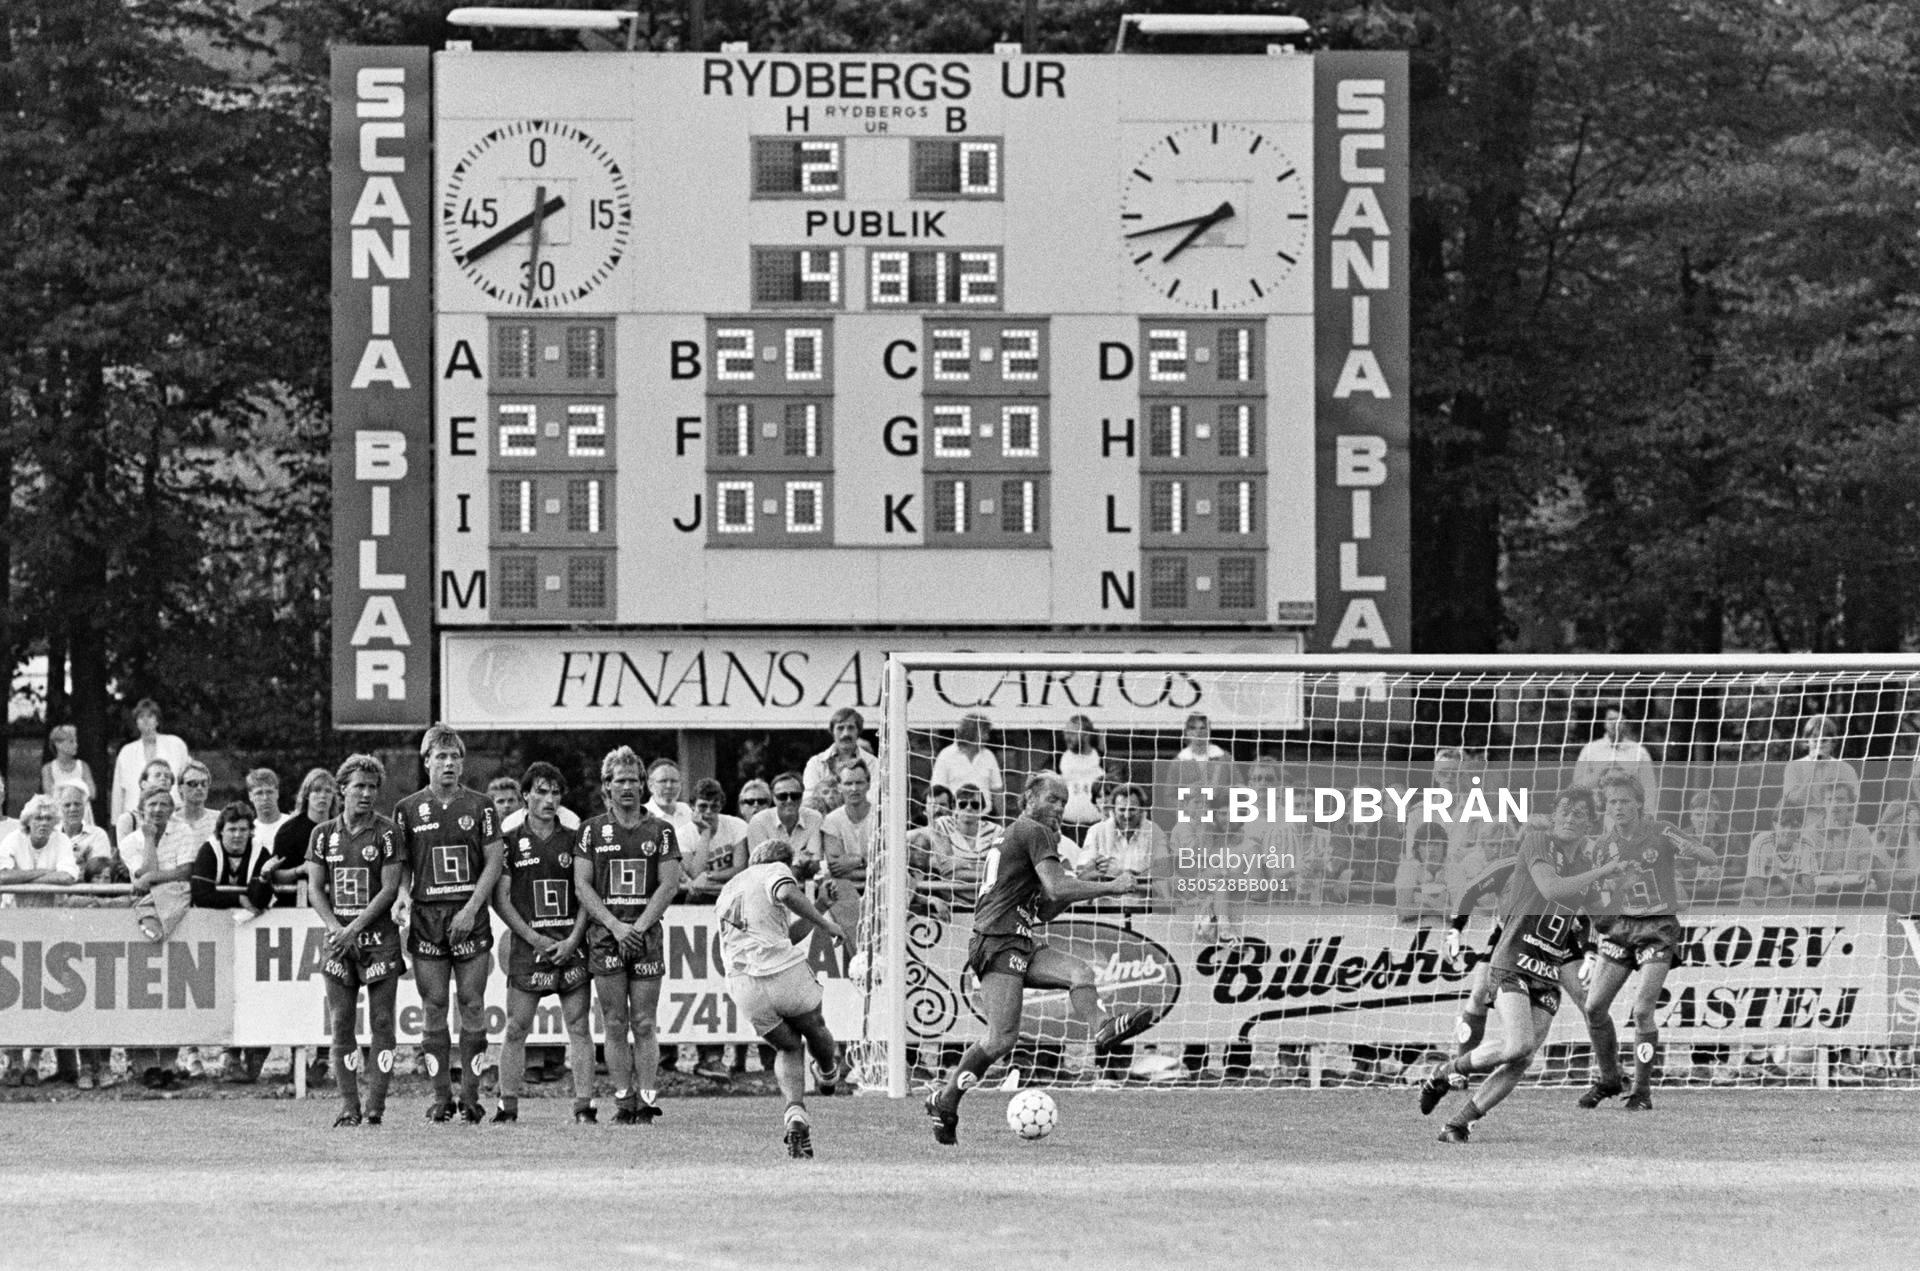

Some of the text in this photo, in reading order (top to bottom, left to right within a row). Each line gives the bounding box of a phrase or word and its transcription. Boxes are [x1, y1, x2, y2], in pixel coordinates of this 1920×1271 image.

[704, 60, 1065, 99] RYDBERGS UR
[787, 106, 808, 132] H
[825, 106, 928, 118] RYDBERGS
[865, 121, 888, 133] UR
[947, 107, 966, 133] B
[530, 138, 545, 167] 0
[803, 142, 838, 192] 2
[961, 143, 997, 193] 0
[462, 199, 497, 228] 45
[591, 200, 614, 229] 15
[807, 211, 945, 237] PUBLIK
[520, 261, 555, 292] 30
[445, 340, 482, 379] A
[671, 341, 701, 380] B
[884, 340, 917, 379] C
[1100, 342, 1133, 380] D
[350, 68, 410, 699] SCANIA BILAR
[1332, 80, 1390, 701] SCANIA BILAR
[450, 417, 476, 456] E
[677, 417, 701, 456] F
[883, 416, 918, 456] G
[1102, 419, 1134, 457] H
[458, 494, 470, 532] I
[673, 494, 701, 532] J
[885, 494, 916, 533] K
[1107, 495, 1131, 533] L
[441, 570, 486, 609] M
[1102, 571, 1134, 609] N
[551, 651, 808, 707] FINANS
[1196, 925, 1501, 1005] Billesho
